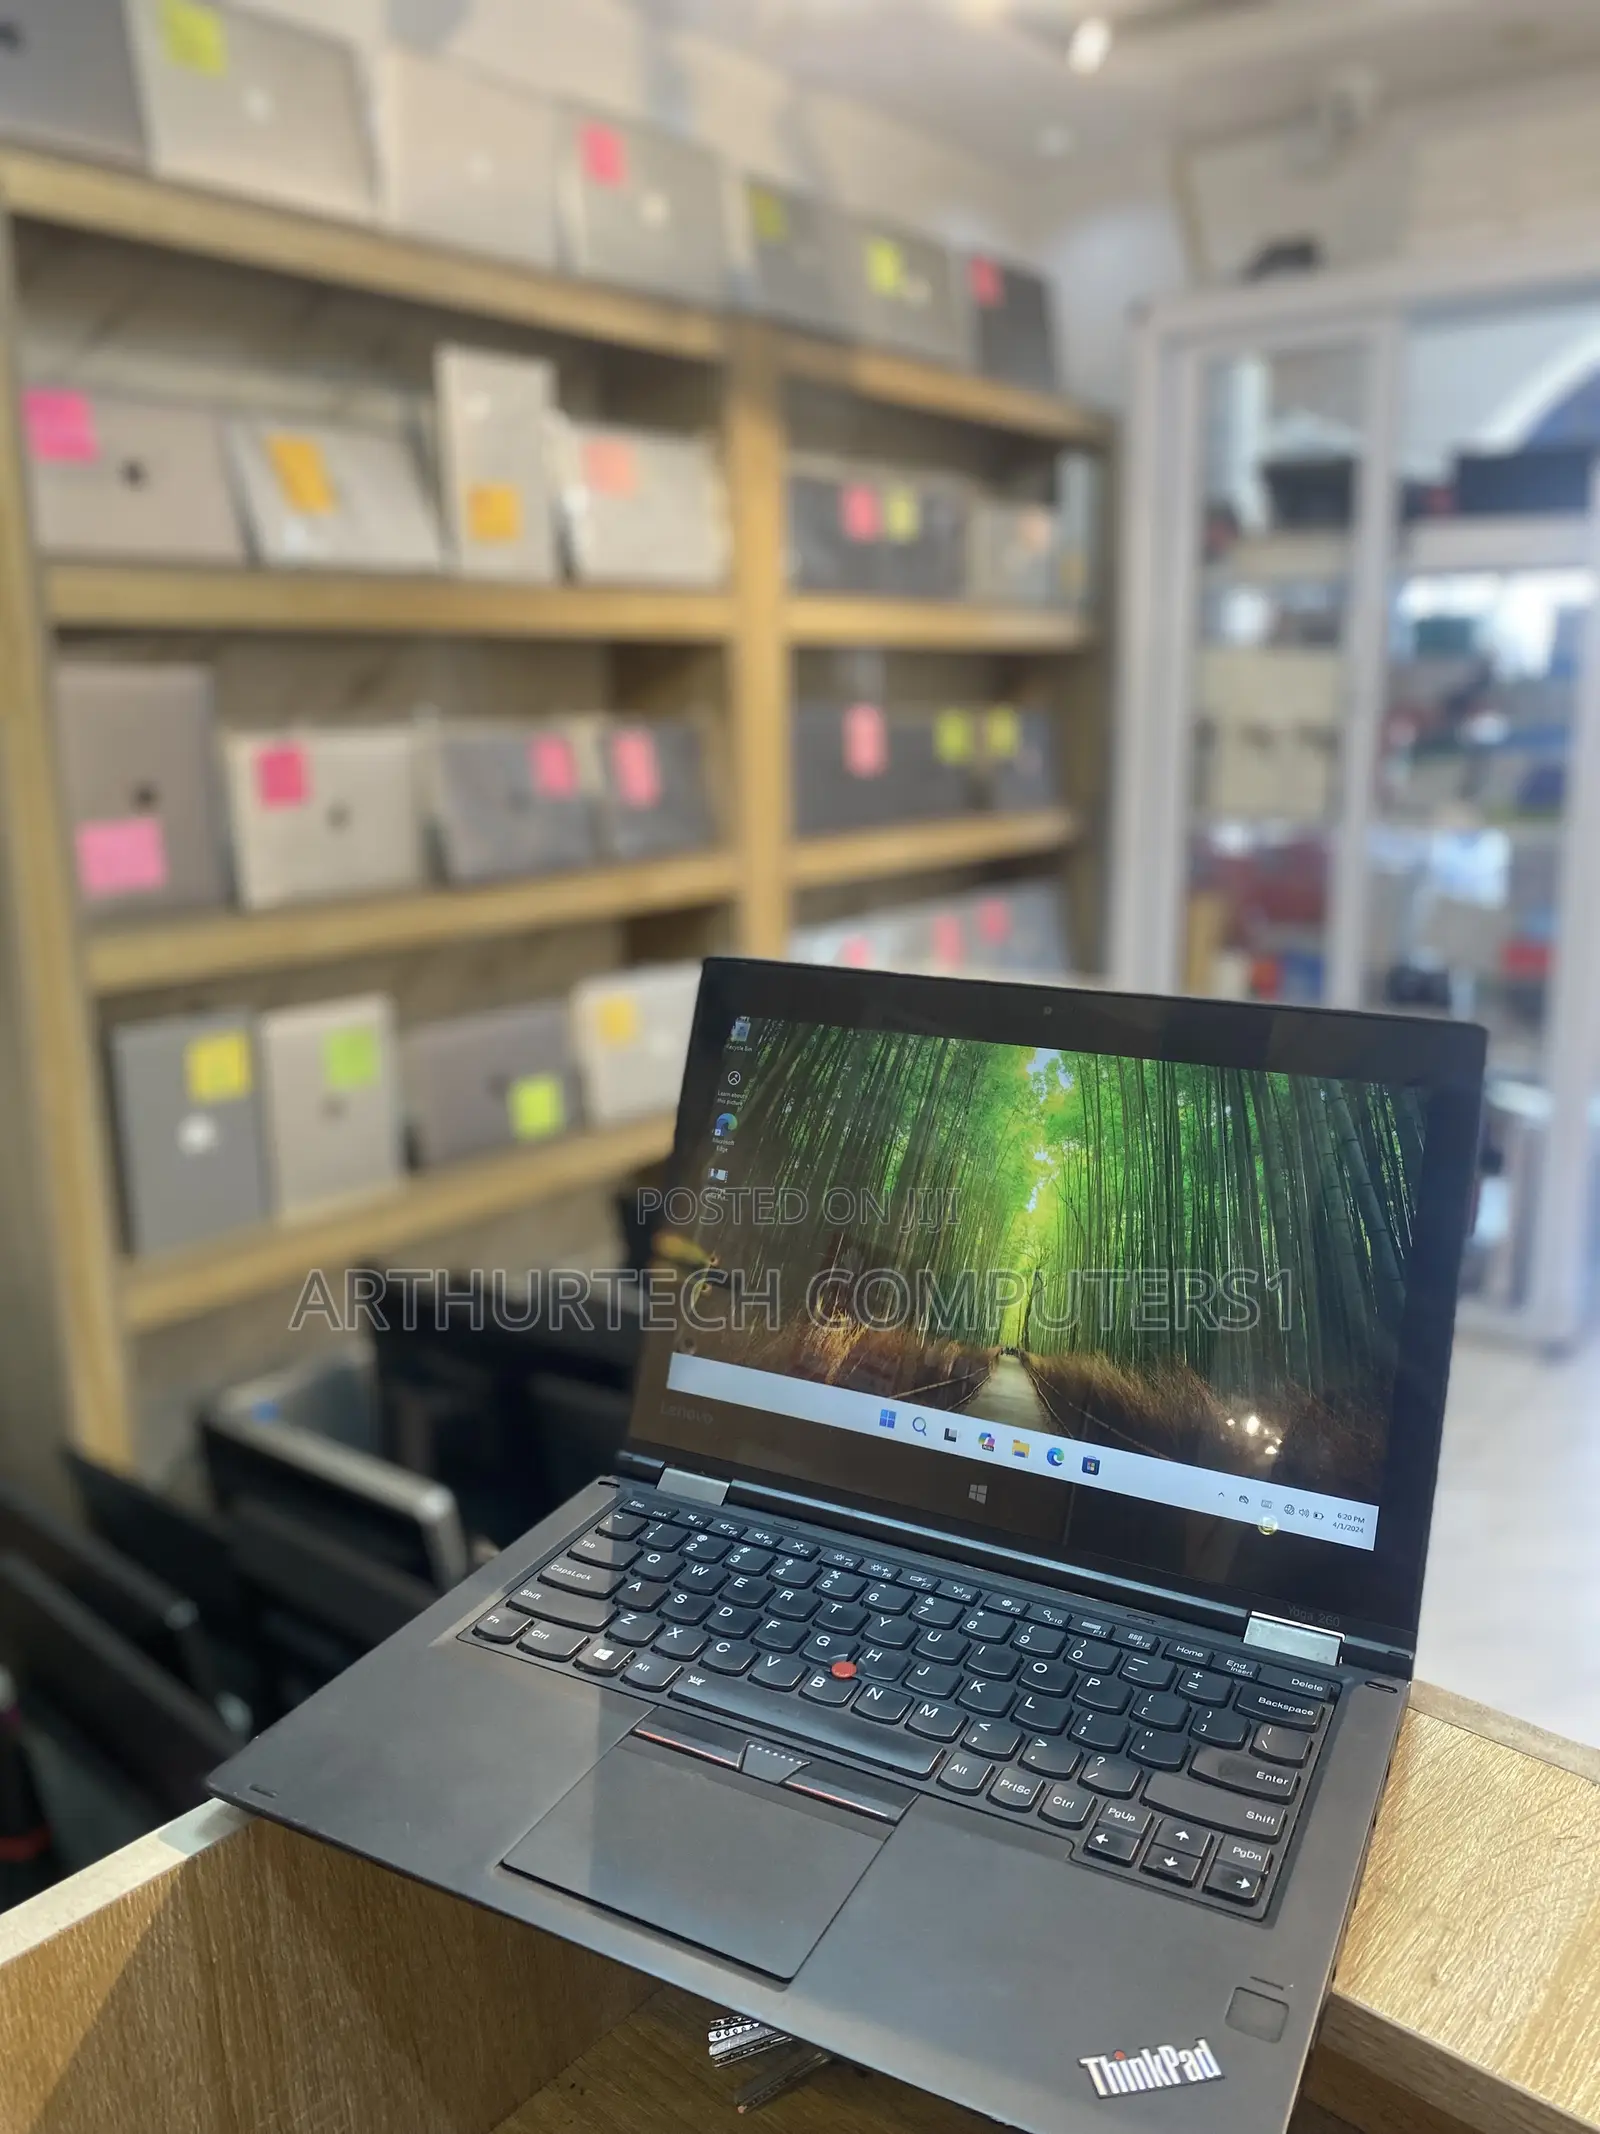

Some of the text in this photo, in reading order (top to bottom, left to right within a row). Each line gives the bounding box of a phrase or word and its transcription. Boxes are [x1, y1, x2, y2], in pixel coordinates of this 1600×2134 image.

[660, 1399, 714, 1425] Lenovo
[630, 1500, 645, 1508] Esc
[1337, 1512, 1365, 1524] 6:20 PM
[1332, 1522, 1364, 1534] 4/1/2024
[580, 1540, 596, 1549] Tab
[686, 1543, 698, 1551] 2
[647, 1553, 661, 1564] Q
[729, 1554, 741, 1563] 3
[550, 1564, 592, 1581] CapsLock
[691, 1564, 709, 1576] W
[775, 1567, 786, 1576] 4
[628, 1581, 642, 1592] A
[733, 1577, 749, 1588] E
[821, 1580, 833, 1588] 5
[520, 1589, 542, 1600] Shift
[673, 1593, 688, 1604] S
[779, 1590, 795, 1601] R
[868, 1592, 880, 1601] 6
[718, 1606, 733, 1617] D
[830, 1603, 843, 1613] T
[917, 1606, 929, 1615] 7
[486, 1615, 500, 1624] Fn
[620, 1613, 638, 1625] Z
[1287, 1602, 1340, 1628] Yoga 260
[765, 1620, 781, 1630] F
[879, 1616, 892, 1627] Y
[966, 1620, 978, 1629] 8
[531, 1629, 550, 1640] Ctrl
[666, 1627, 684, 1639] X
[927, 1630, 942, 1642] U
[816, 1635, 831, 1647] G
[1019, 1635, 1030, 1644] 9
[715, 1642, 731, 1653] C
[1176, 1645, 1204, 1658] Home
[866, 1649, 883, 1661] H
[766, 1655, 781, 1667] V
[1226, 1659, 1247, 1670] End
[635, 1662, 650, 1672] Alt
[916, 1666, 931, 1676] J
[1032, 1662, 1048, 1674] O
[1230, 1666, 1253, 1676] Insert
[810, 1676, 826, 1687] B
[970, 1680, 986, 1693] K
[1086, 1677, 1101, 1687] P
[1291, 1678, 1324, 1692] Delete
[866, 1687, 884, 1700] N
[1024, 1696, 1036, 1709] L
[1258, 1696, 1314, 1716] Backspace
[919, 1704, 939, 1718] M
[951, 1763, 969, 1775] Alt
[1256, 1771, 1289, 1786] Enter
[1000, 1778, 1032, 1796] PrtSc
[1052, 1796, 1075, 1809] Ctrl
[1107, 1806, 1137, 1822] PgUp
[1245, 1810, 1276, 1825] Shift
[1232, 1846, 1263, 1862] PgDn
[1079, 2037, 1224, 2097] ThinkPad
